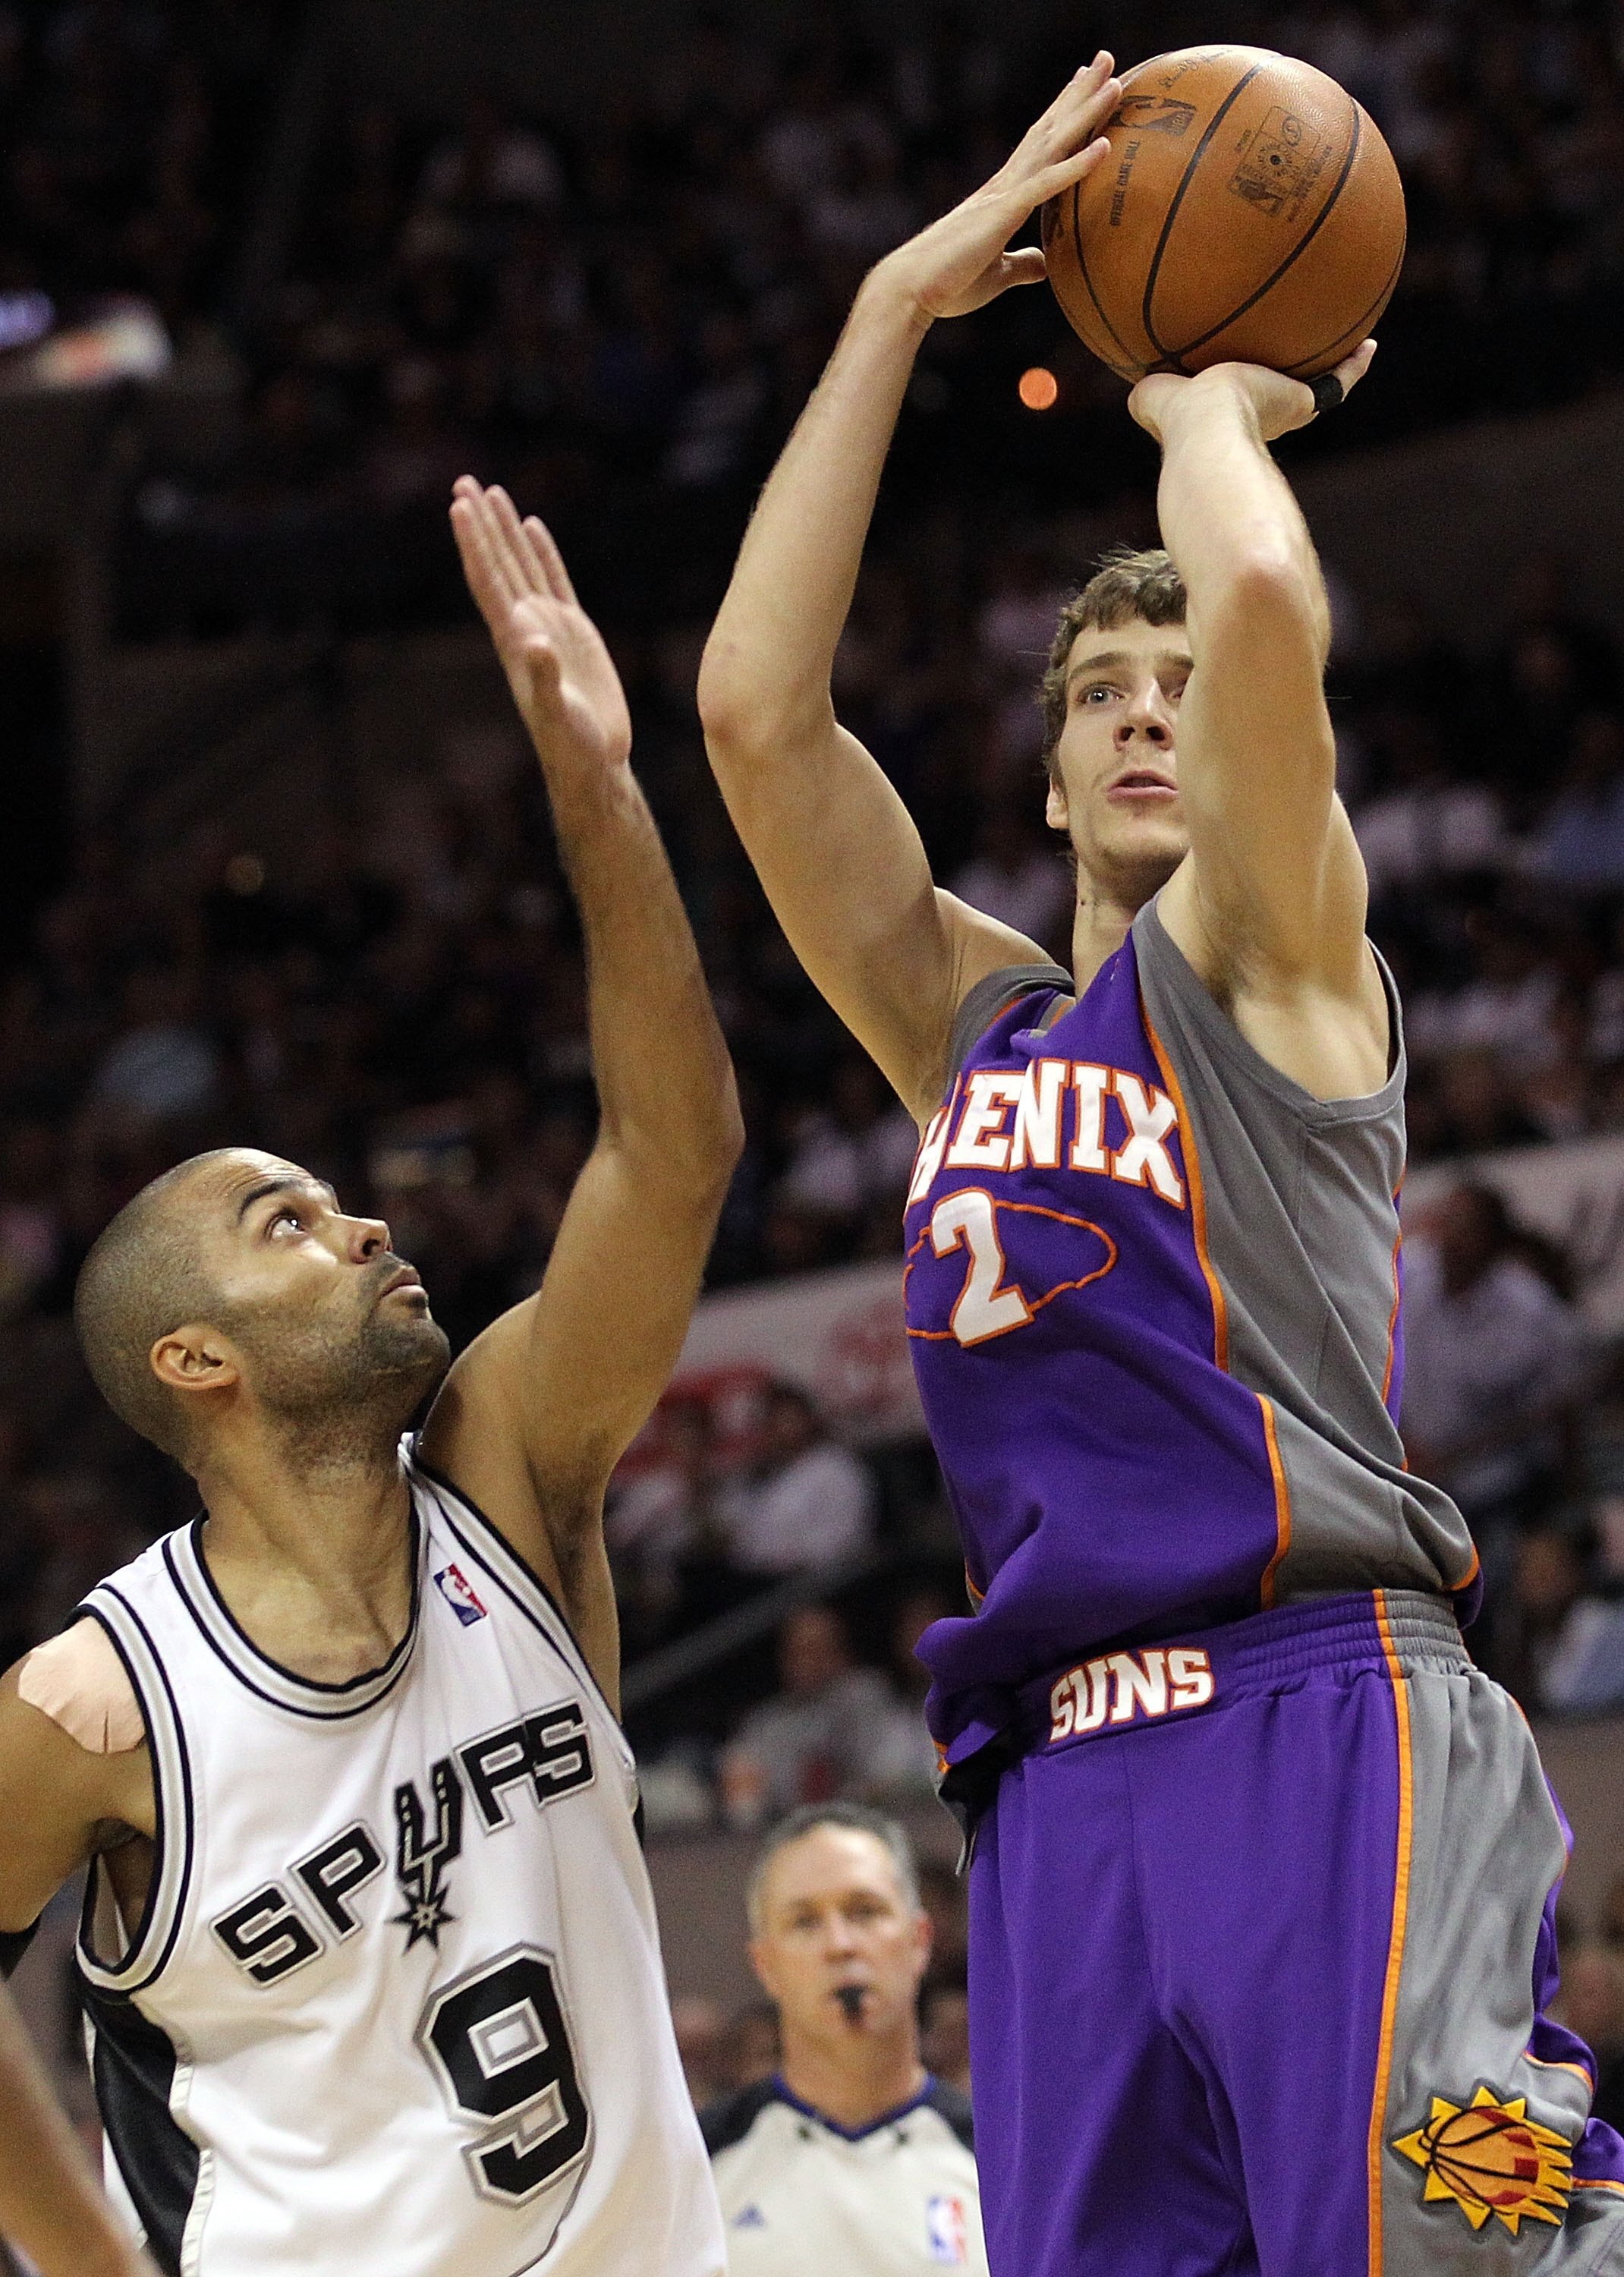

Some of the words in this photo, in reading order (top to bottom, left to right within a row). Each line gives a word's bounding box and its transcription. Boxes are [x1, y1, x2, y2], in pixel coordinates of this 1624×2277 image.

[930, 1186, 1035, 1349] 2
[1050, 1646, 1215, 1743] SUNS
[209, 1697, 596, 1989] SPURS
[412, 1941, 596, 2210] 9
